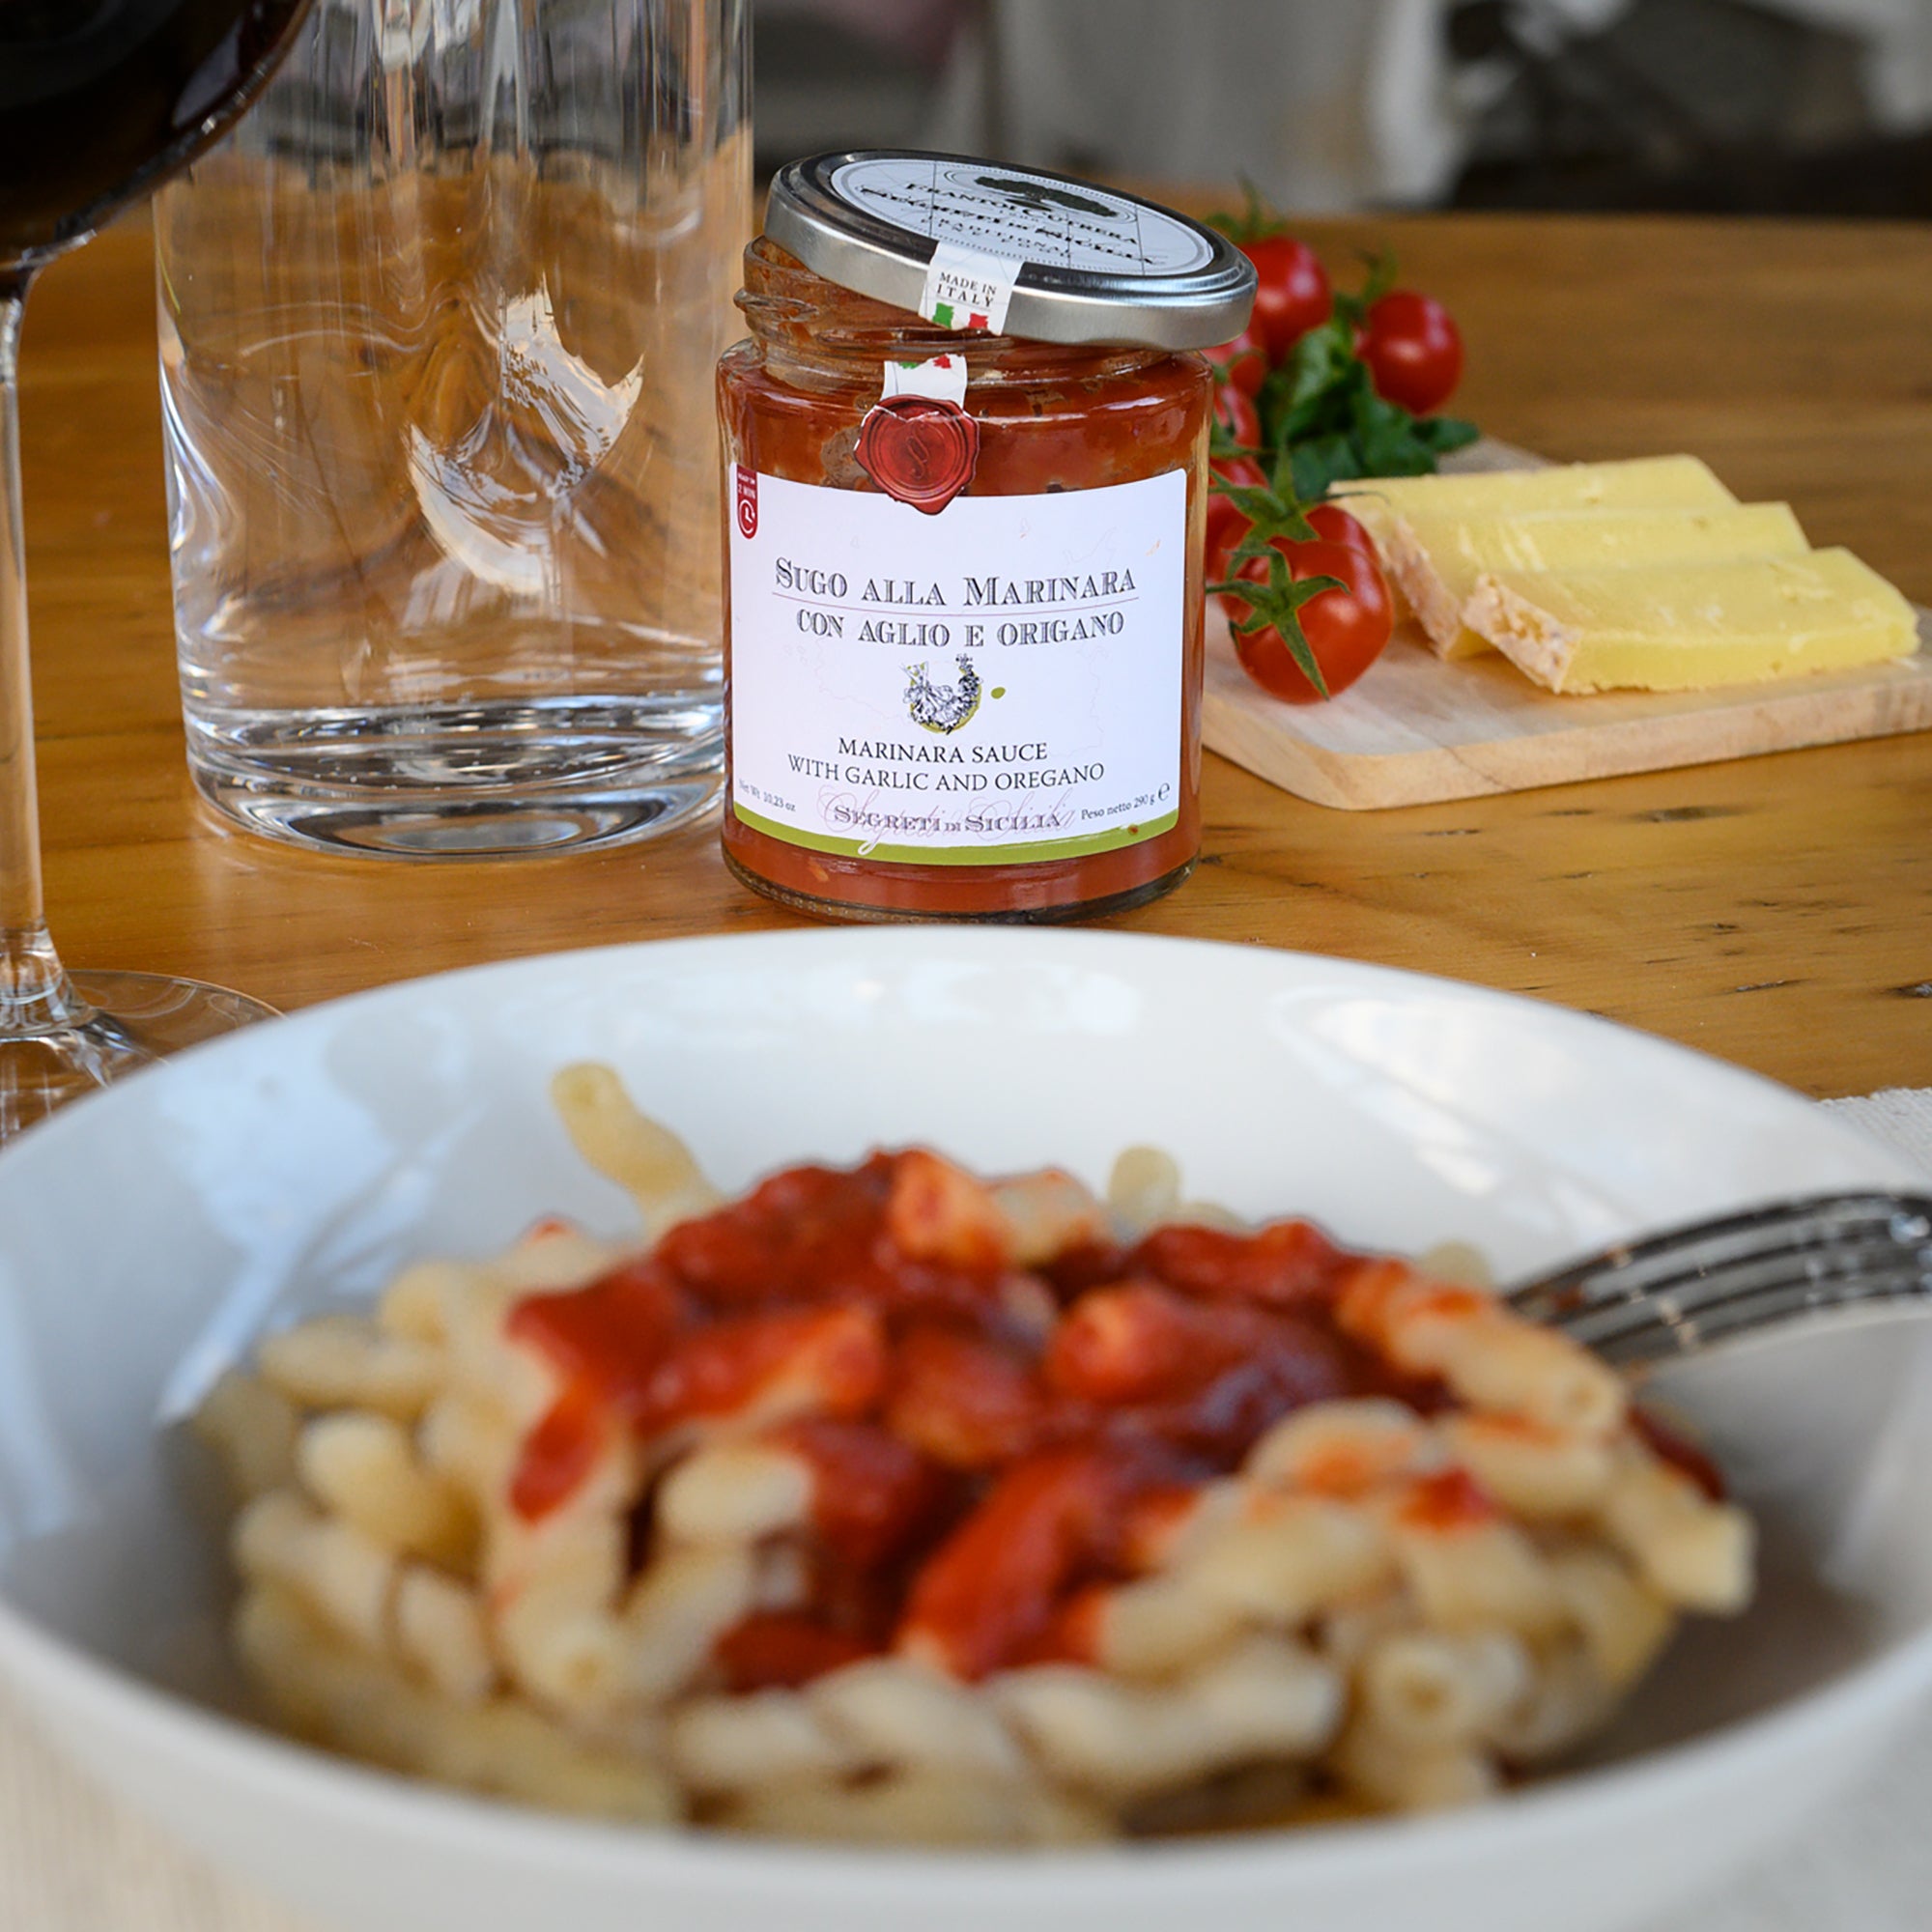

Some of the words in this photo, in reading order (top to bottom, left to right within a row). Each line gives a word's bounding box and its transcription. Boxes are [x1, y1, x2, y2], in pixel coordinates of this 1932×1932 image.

[937, 284, 993, 307] ITALY
[939, 271, 979, 290] MADE
[981, 284, 997, 295] IN
[861, 578, 948, 606] ALLA
[963, 568, 1136, 607] MARINARA
[797, 609, 844, 639] CON
[858, 620, 950, 647] AGLIO
[964, 624, 984, 647] E
[997, 611, 1124, 647] ORIGANO
[838, 737, 964, 764] MARINARA
[971, 742, 1048, 764] SAUCE
[787, 753, 839, 781] WITH
[845, 766, 928, 791] GARLIC
[935, 773, 987, 791] AND
[995, 762, 1105, 791] OREGANO
[1081, 808, 1105, 820] Peso
[1106, 802, 1132, 815] netto
[1134, 793, 1150, 809] 290
